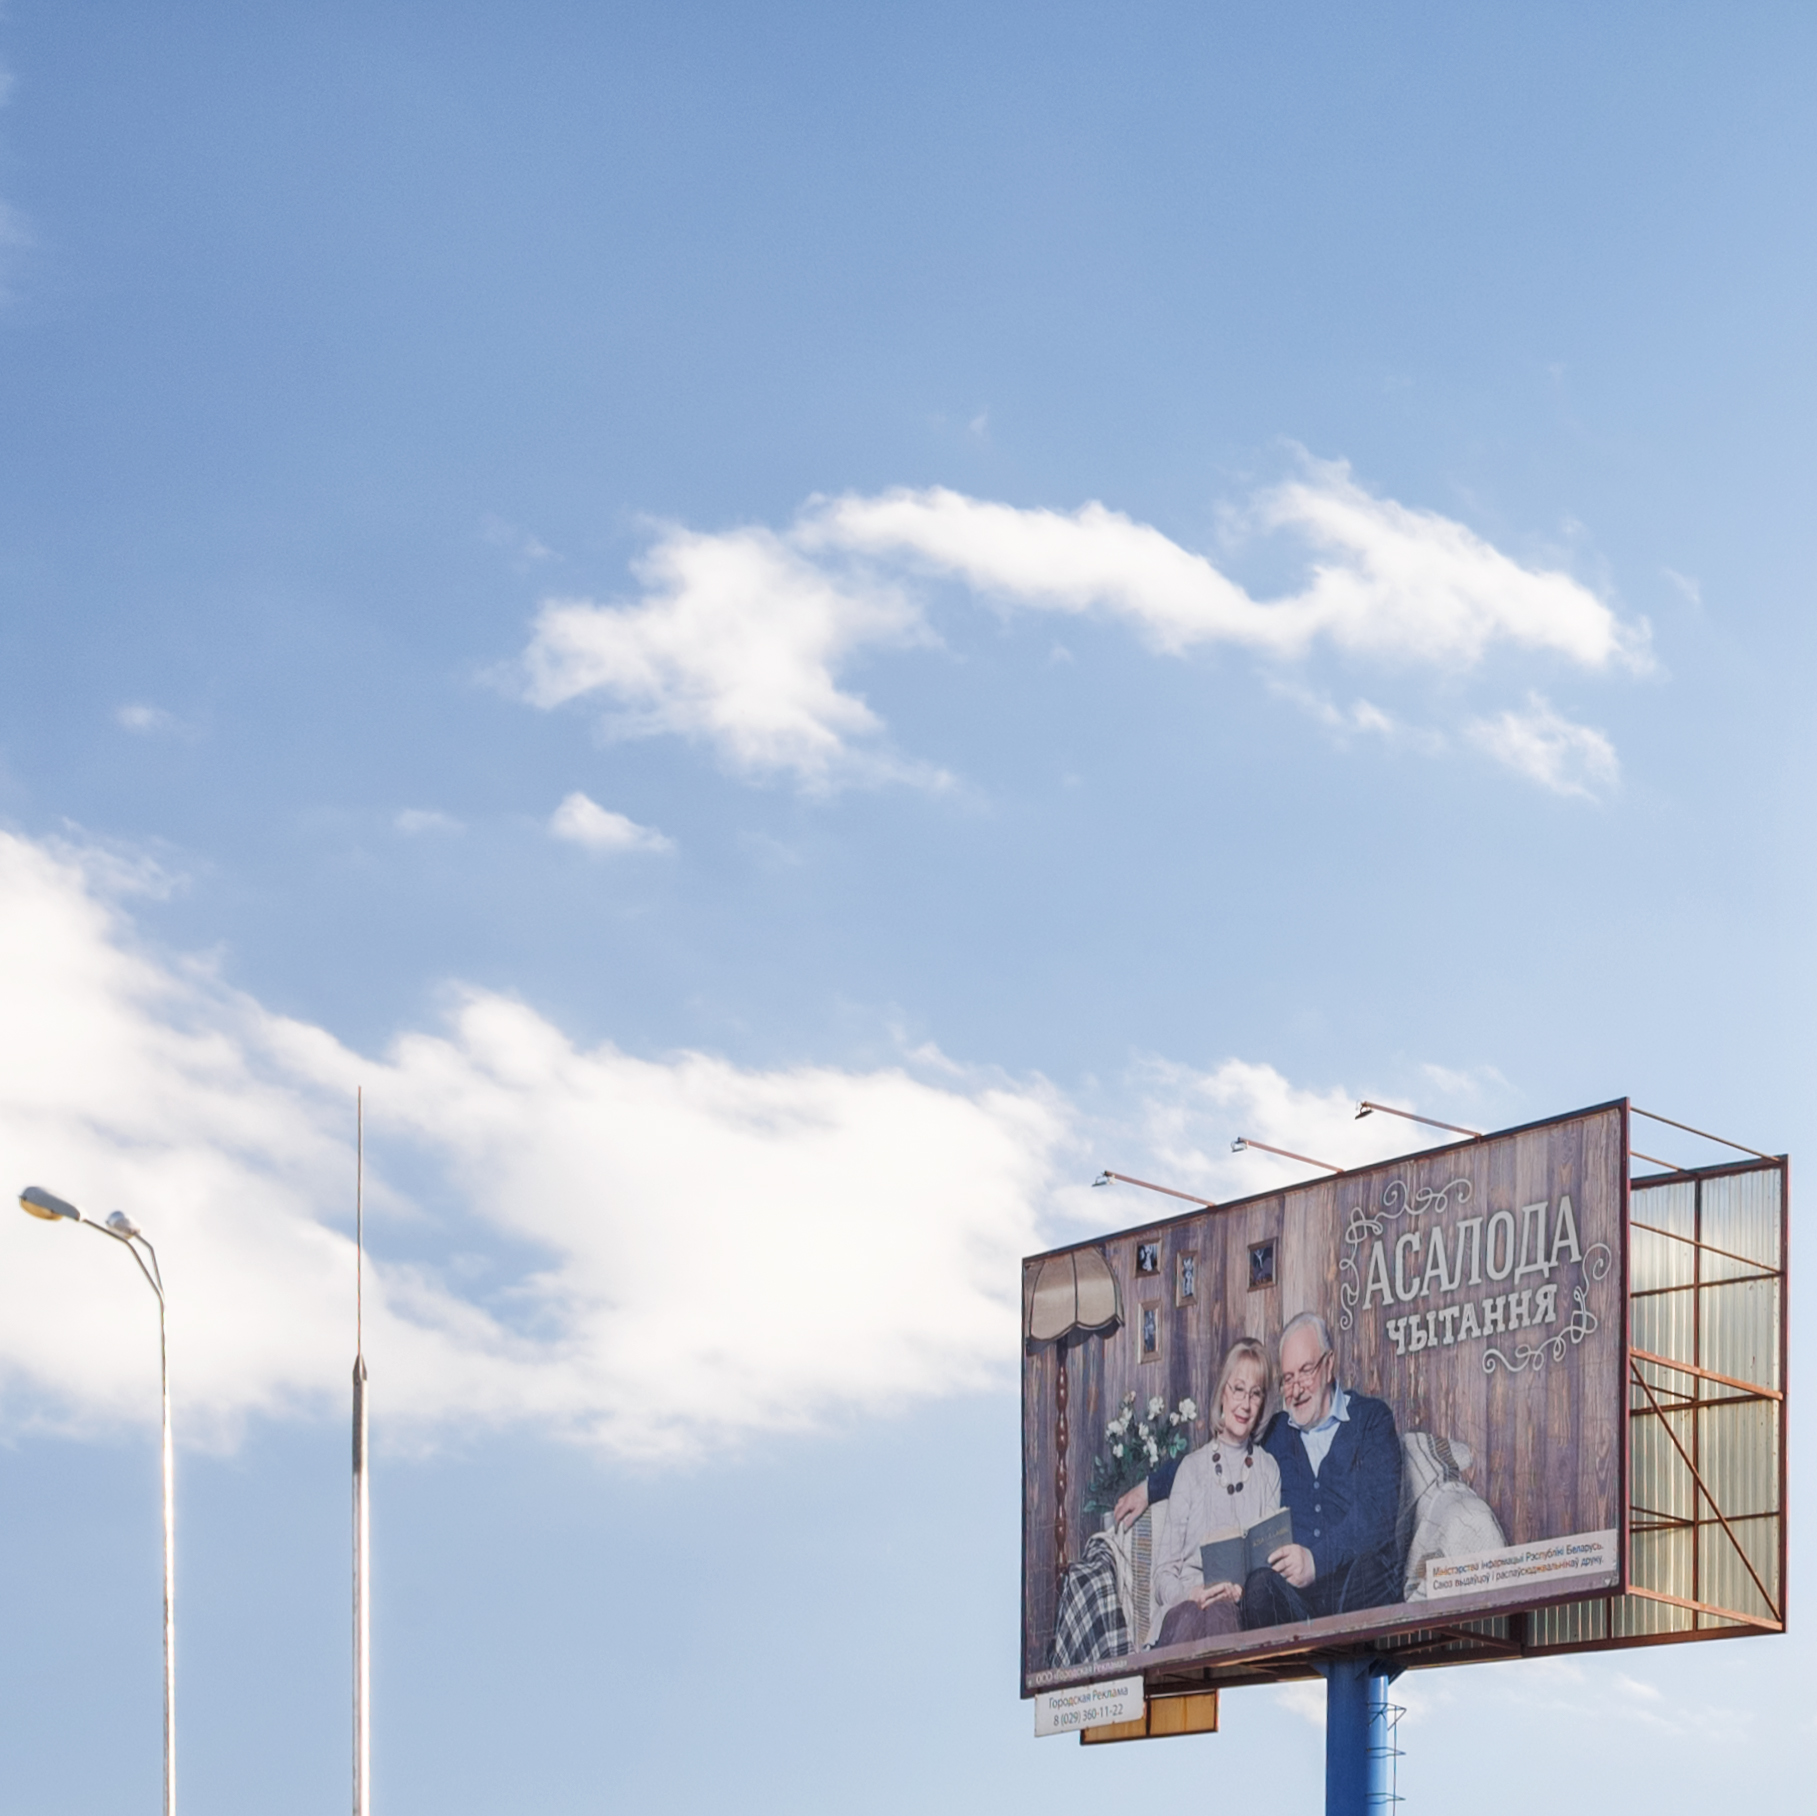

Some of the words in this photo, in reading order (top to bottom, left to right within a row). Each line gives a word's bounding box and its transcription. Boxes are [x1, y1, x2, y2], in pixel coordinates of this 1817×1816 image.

[1362, 1195, 1582, 1310] АСАЛОДА
[1386, 1284, 1558, 1356] ЧЫТАННЯ
[1526, 1547, 1565, 1562] Рэспублікі
[1566, 1542, 1603, 1556] Беларусь.
[1049, 1693, 1091, 1710] Городская
[1092, 1687, 1129, 1700] Реклама
[1053, 1715, 1060, 1726] 8
[1061, 1711, 1081, 1726] (029)
[1082, 1703, 1124, 1721] 360-11-22
